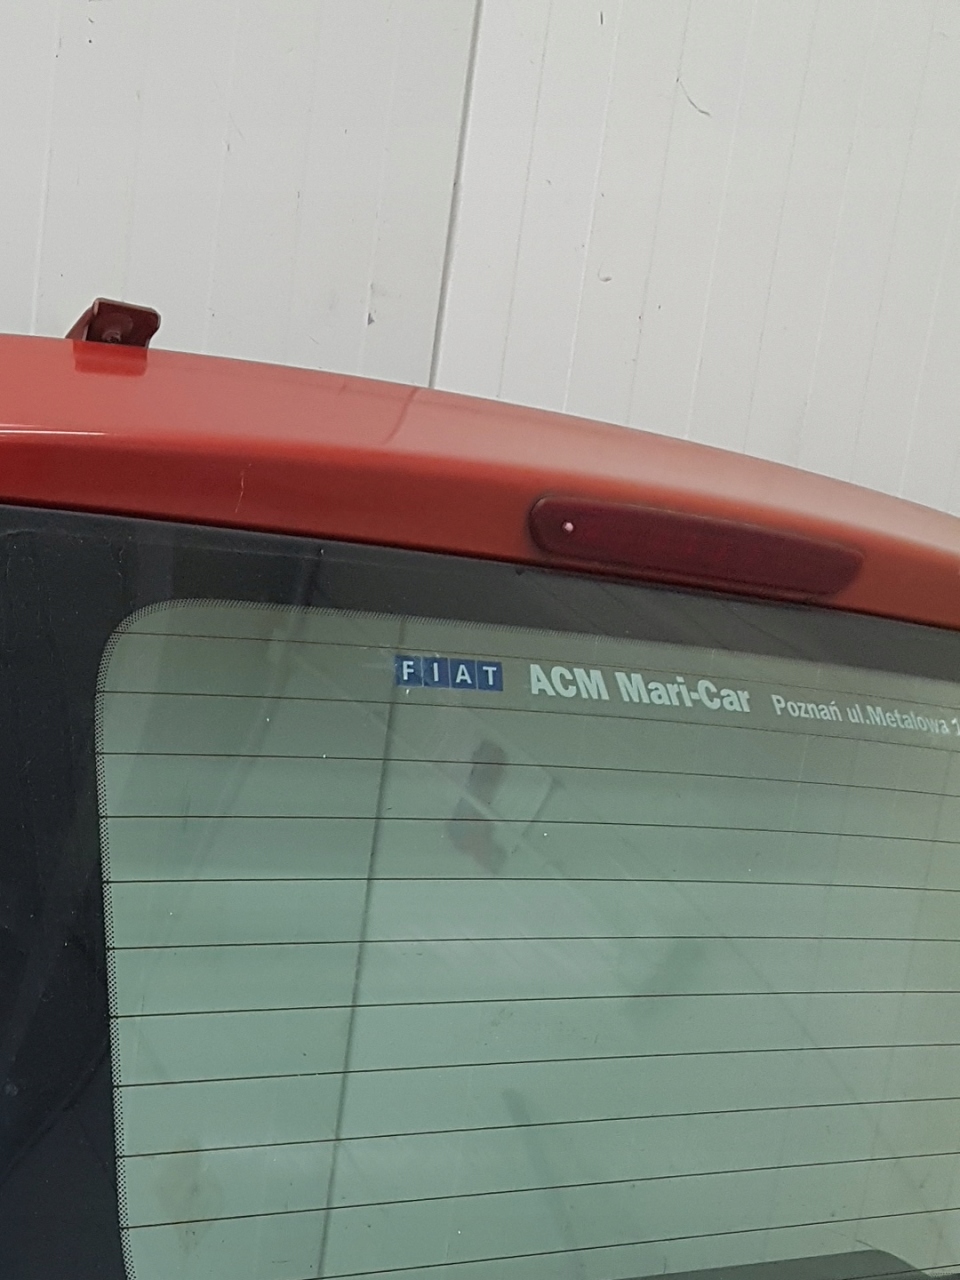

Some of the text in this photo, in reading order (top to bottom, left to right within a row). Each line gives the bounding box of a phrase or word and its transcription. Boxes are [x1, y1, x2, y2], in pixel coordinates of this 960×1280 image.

[402, 660, 497, 686] FIAT
[529, 663, 610, 698] ACM
[614, 671, 751, 712] Mari-Car
[770, 694, 843, 722] Poznań
